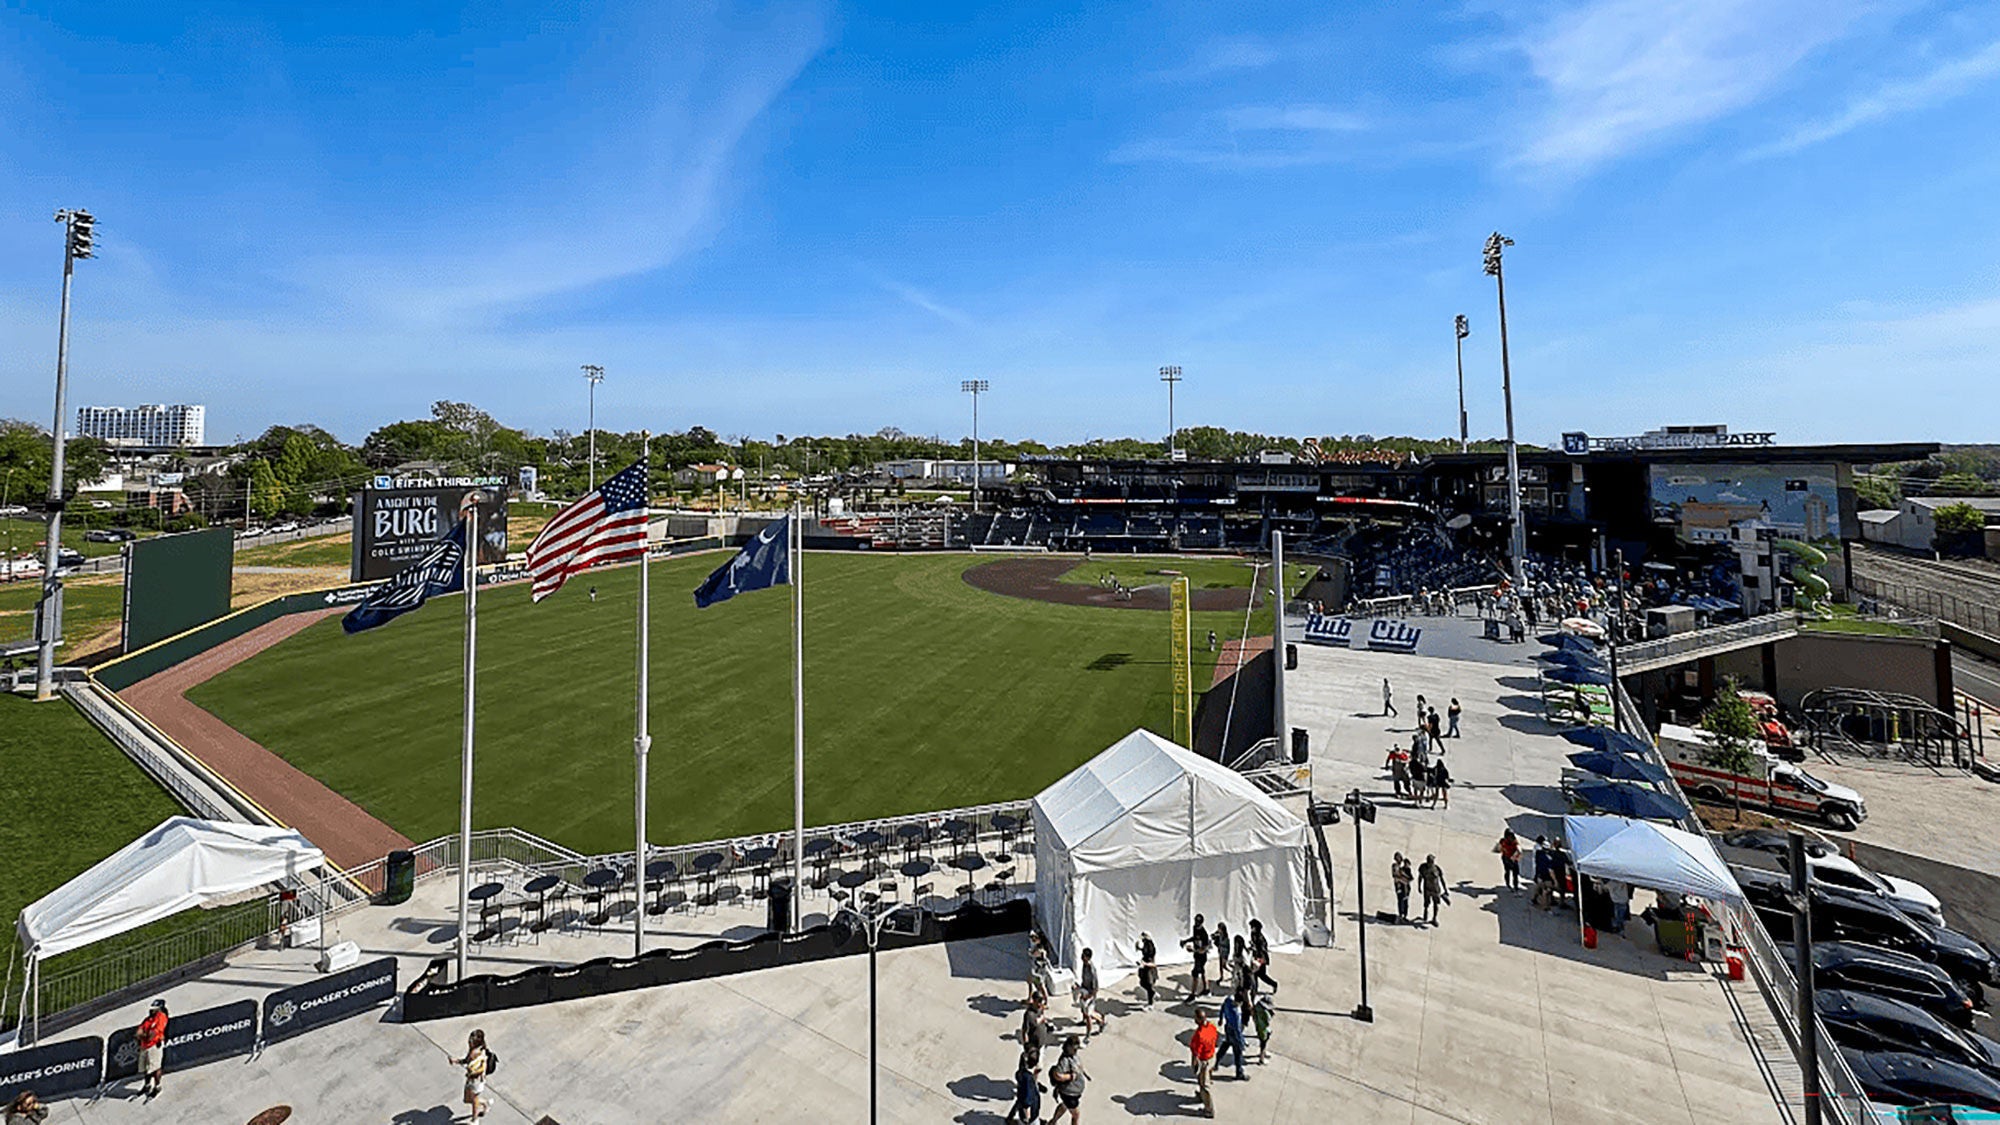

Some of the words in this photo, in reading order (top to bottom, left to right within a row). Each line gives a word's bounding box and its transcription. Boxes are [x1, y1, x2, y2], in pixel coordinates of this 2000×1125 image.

[1716, 432, 1776, 445] PARK
[395, 478, 432, 488] FIFTH
[435, 476, 471, 487] THIRD
[376, 499, 383, 509] A
[385, 497, 410, 509] NIGHT
[412, 496, 422, 507] IN
[373, 507, 437, 538] BURG
[371, 548, 395, 558] COLE
[1305, 614, 1352, 636] Hub
[1370, 620, 1422, 649] City
[300, 988, 350, 1011] CHASER'S
[350, 974, 393, 994] CORNER
[162, 1029, 203, 1048] ASER'S
[203, 1018, 252, 1038] CORNER
[43, 1057, 96, 1076] CORNER
